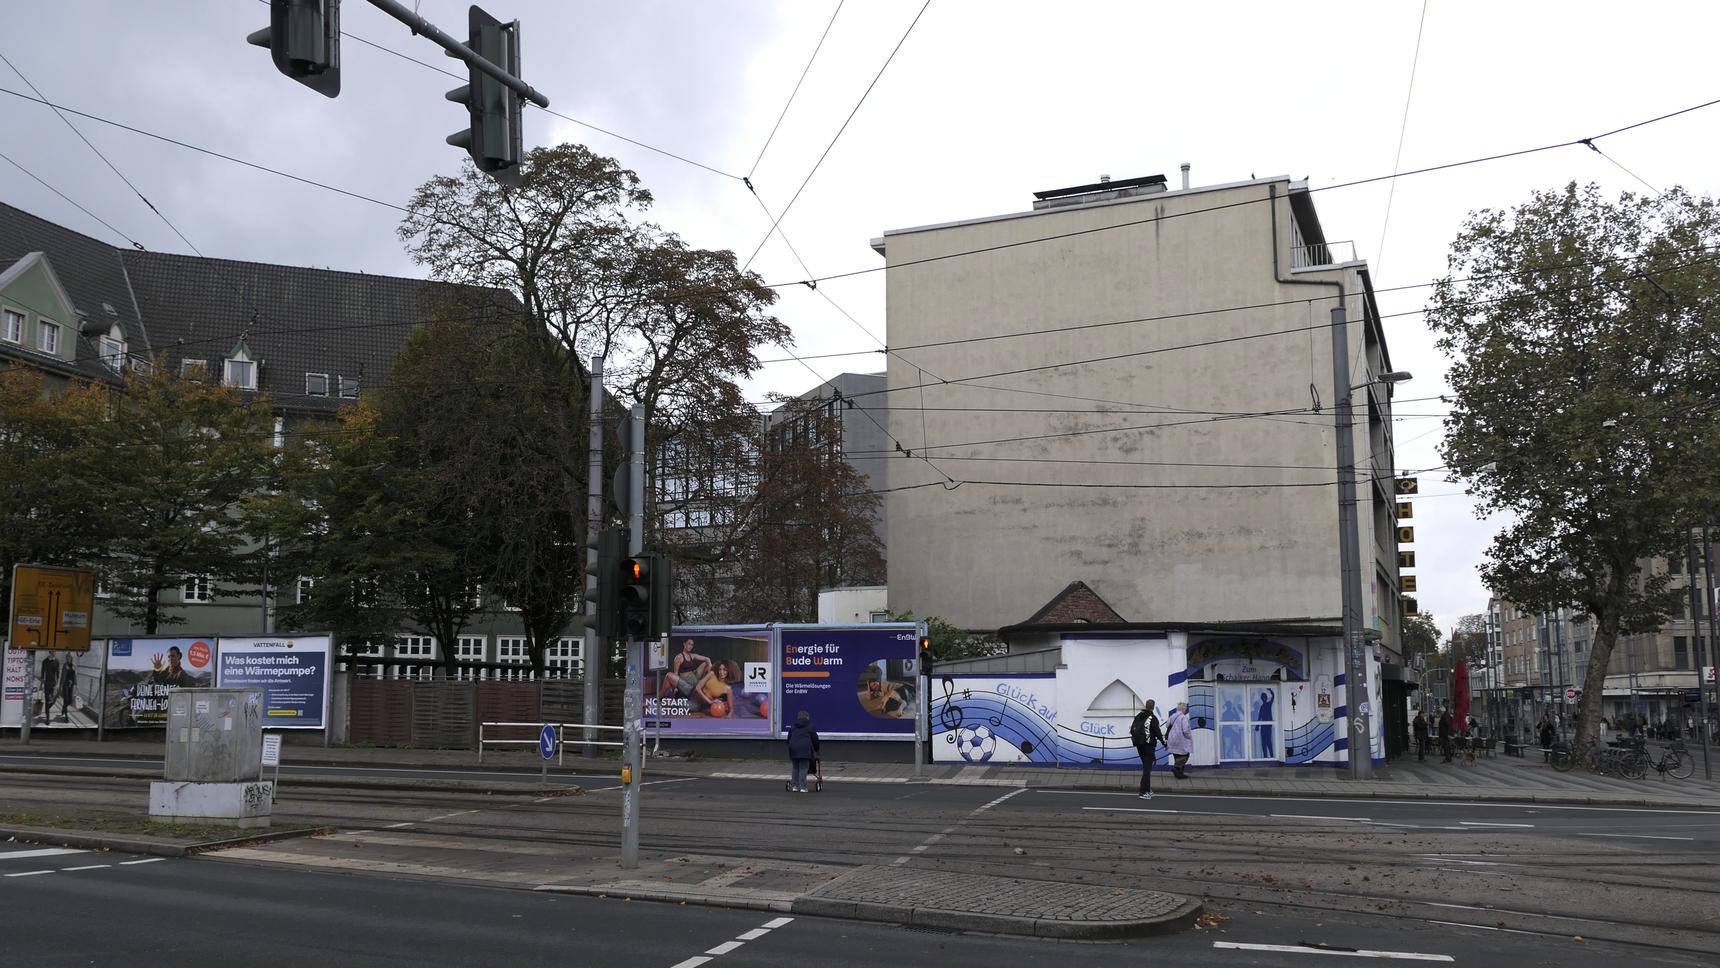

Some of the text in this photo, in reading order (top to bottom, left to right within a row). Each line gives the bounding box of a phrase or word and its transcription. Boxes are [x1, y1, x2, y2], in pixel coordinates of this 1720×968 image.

[1398, 502, 1417, 616] HOTEL
[785, 643, 840, 656] Energie für
[225, 655, 299, 665] Was kostet mich
[785, 656, 843, 666] Bude Warm
[224, 665, 316, 678] eine Wärmepumpe?
[749, 667, 766, 680] JR
[1242, 665, 1257, 673] Zum
[136, 684, 154, 697] DEINE
[661, 698, 689, 706] START.
[996, 682, 1057, 723] Glück auf
[661, 707, 691, 716] STORY.
[1080, 720, 1116, 736] Glück
